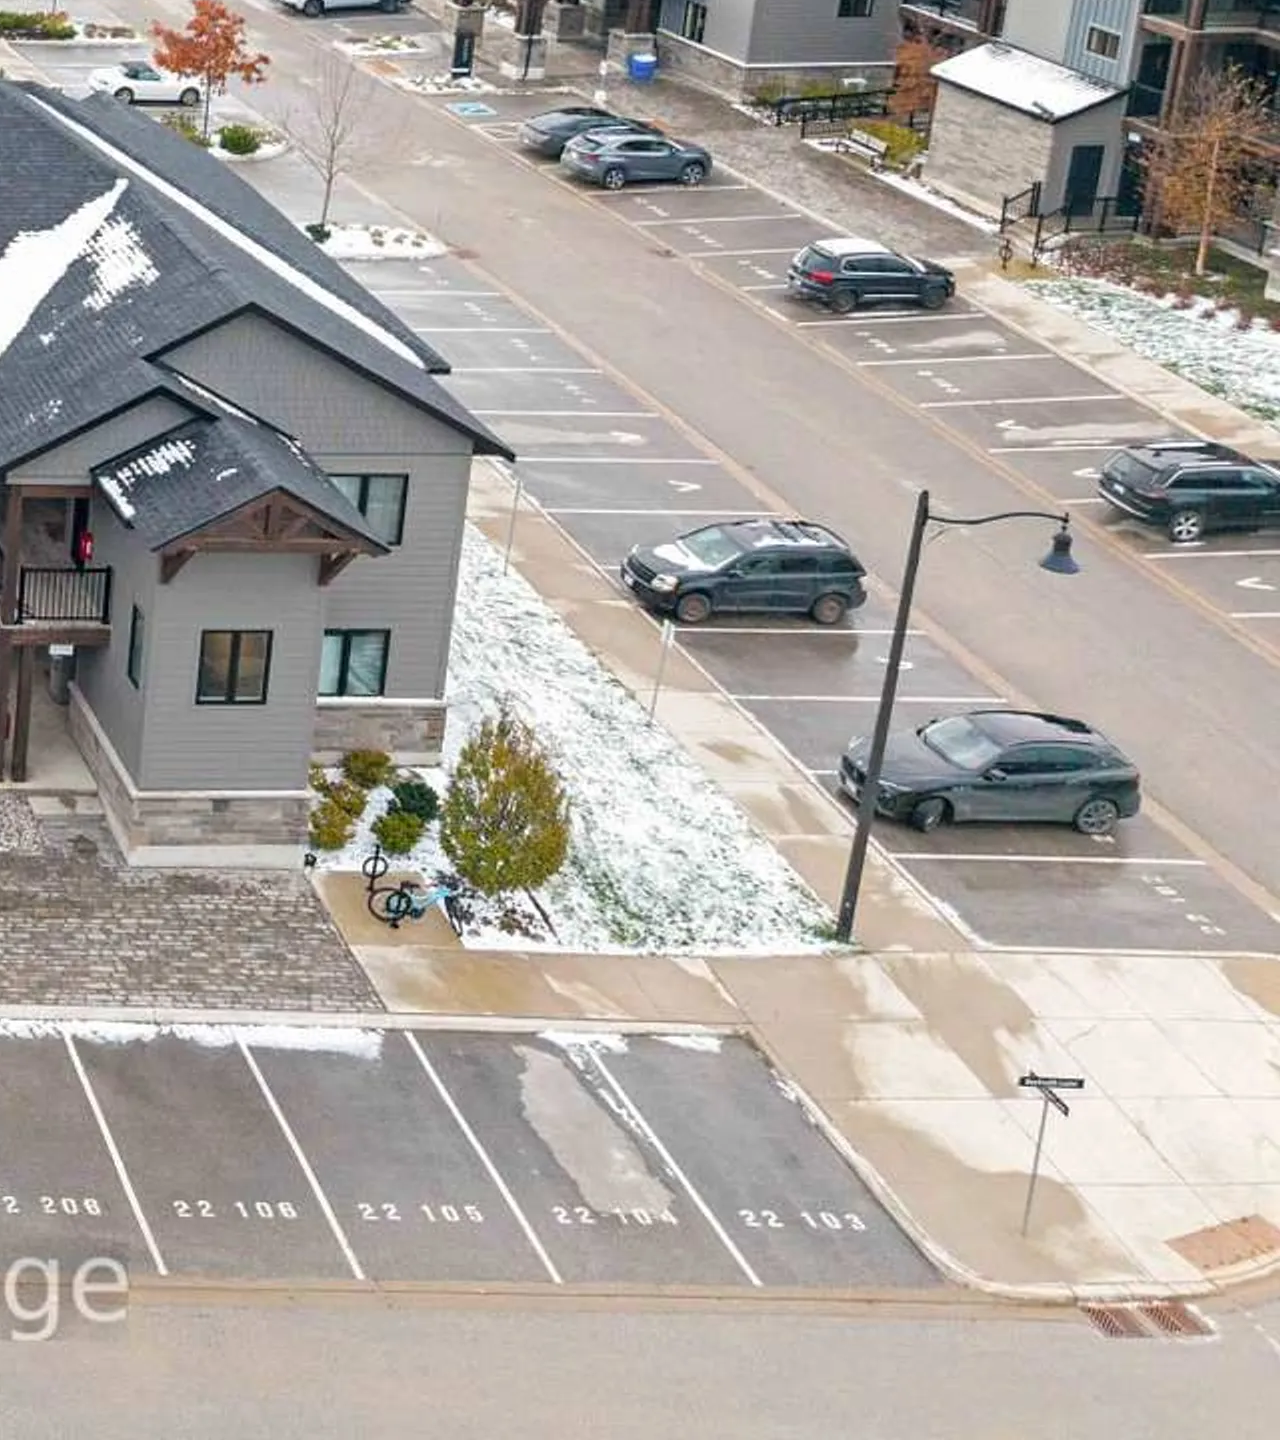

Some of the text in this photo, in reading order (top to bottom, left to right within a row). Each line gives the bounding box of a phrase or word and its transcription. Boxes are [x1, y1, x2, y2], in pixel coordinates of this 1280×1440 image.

[173, 1199, 216, 1218] 22
[357, 1202, 484, 1223] 22 105
[551, 1205, 596, 1225] 22
[739, 1209, 866, 1231] 22 103
